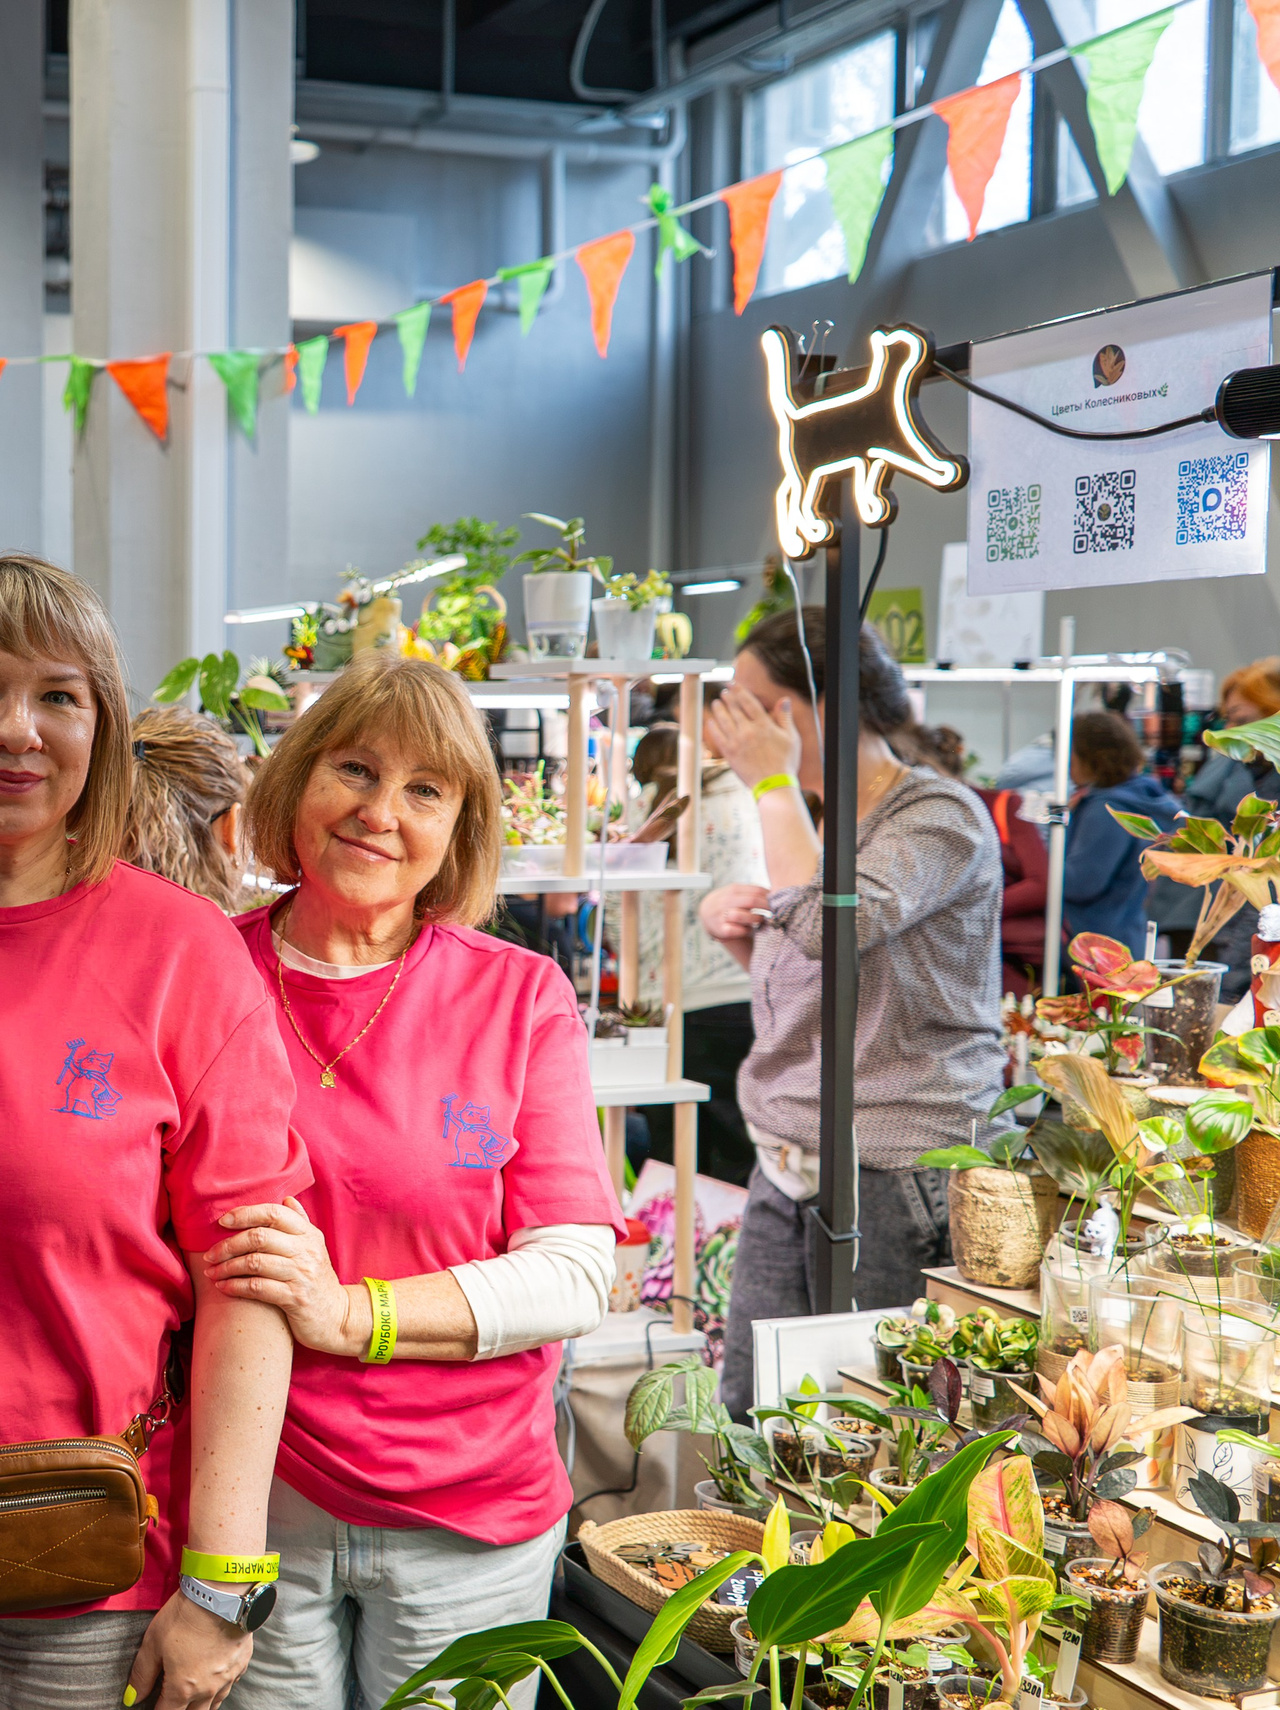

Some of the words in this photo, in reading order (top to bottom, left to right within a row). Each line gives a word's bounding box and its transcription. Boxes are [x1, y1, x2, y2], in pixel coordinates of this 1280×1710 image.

[1051, 402, 1083, 416] Цветы
[1084, 388, 1158, 410] Колесниковых
[374, 1310, 391, 1360] ГРОУБОКС
[224, 1562, 264, 1574] МАРКЕТ
